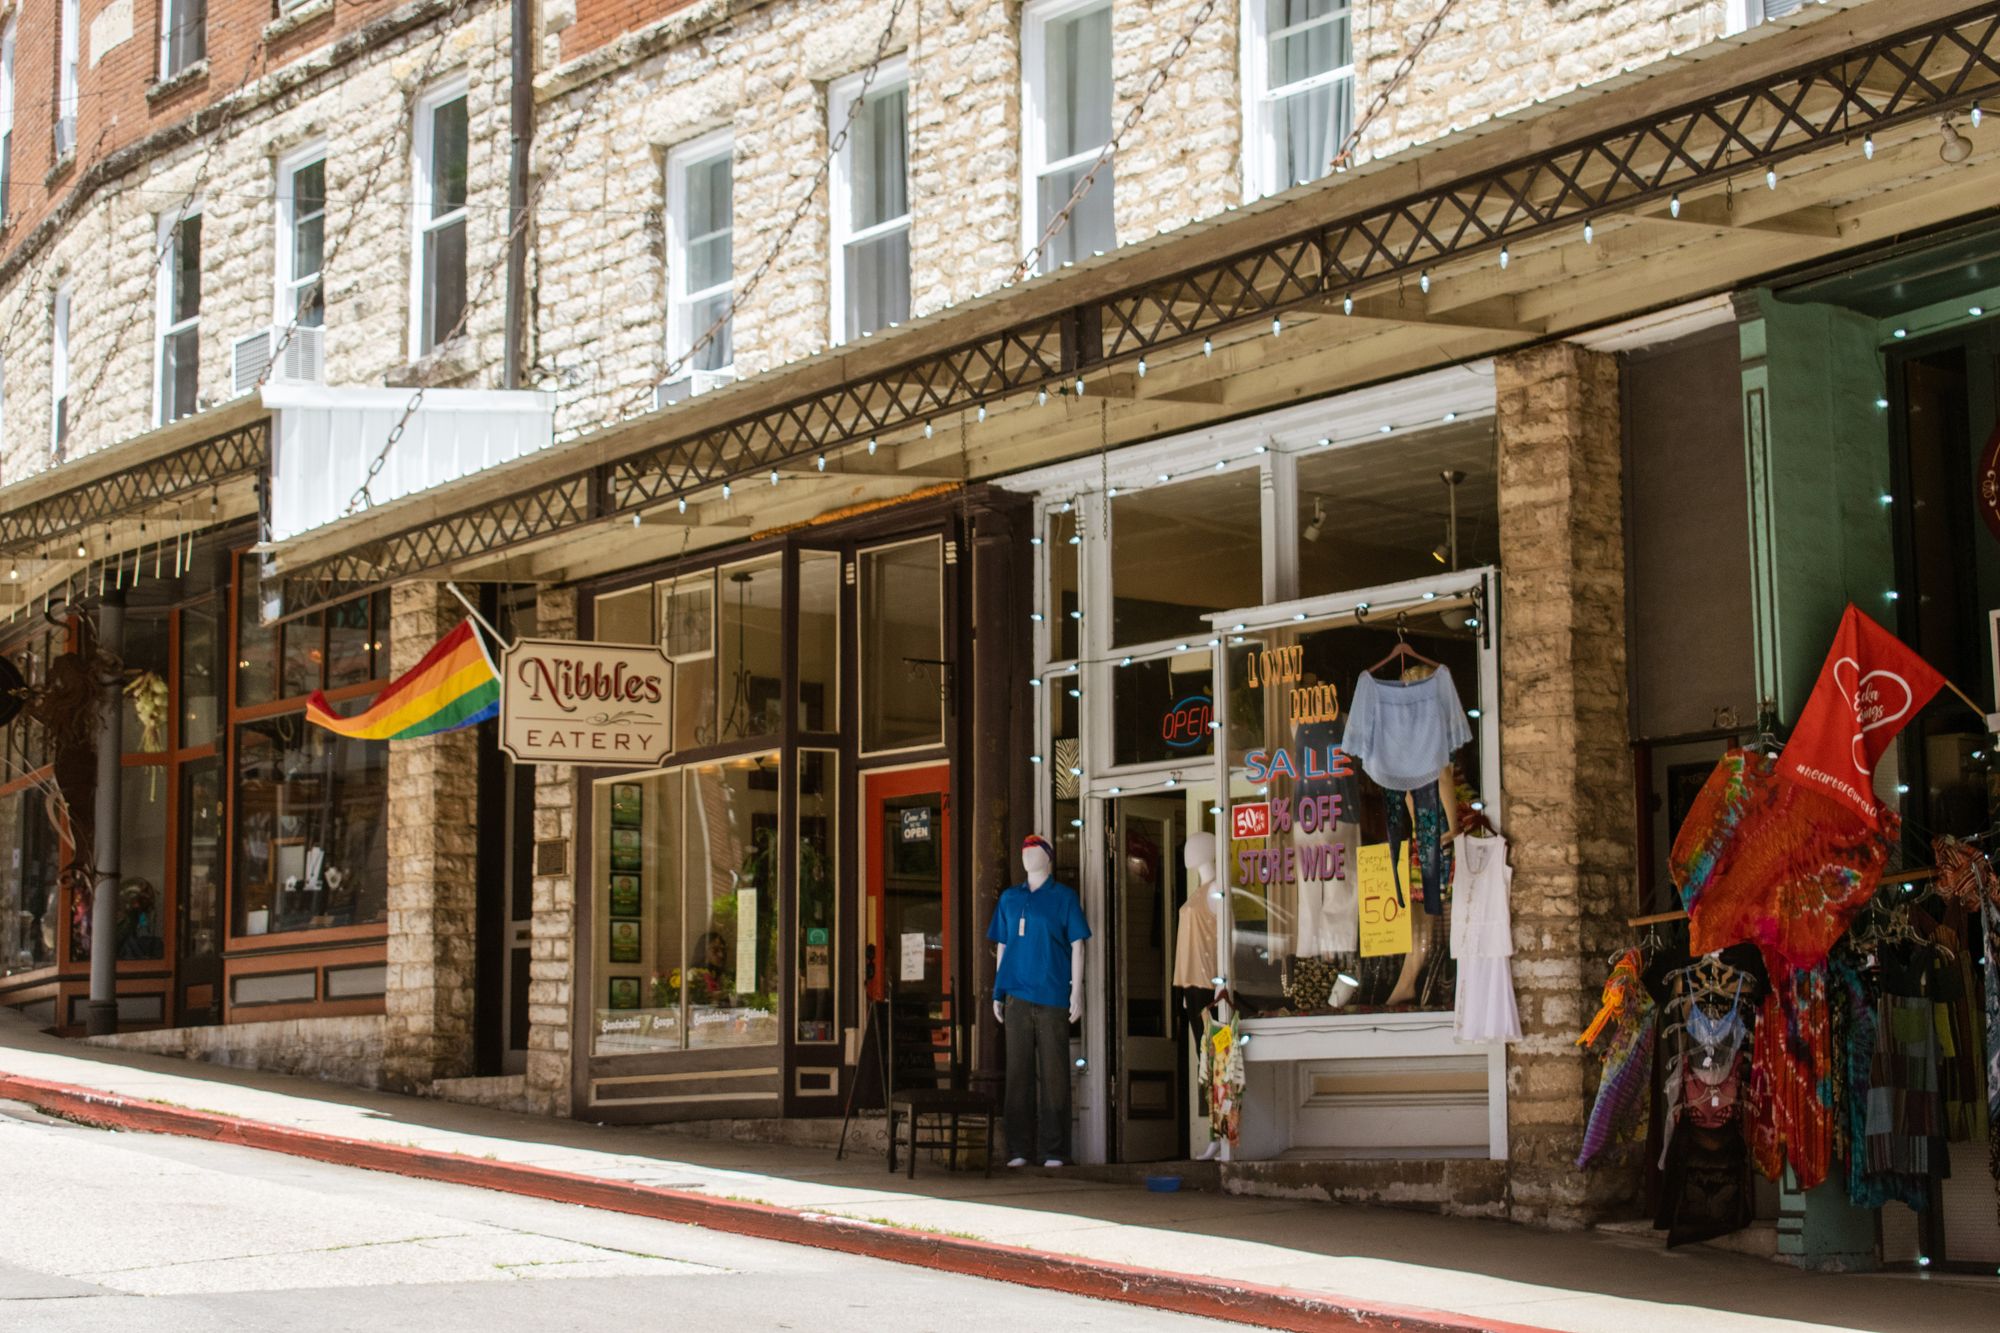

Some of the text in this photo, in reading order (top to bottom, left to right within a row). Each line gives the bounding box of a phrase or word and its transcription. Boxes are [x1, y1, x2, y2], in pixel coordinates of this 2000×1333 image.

[518, 657, 662, 712] Nibbles
[1248, 645, 1303, 688] LOWEST
[1163, 705, 1214, 739] OPEN
[1290, 684, 1339, 725] PRICES
[527, 730, 653, 750] EATERY
[1245, 744, 1353, 784] SALE
[1299, 795, 1342, 832] OFF
[904, 827, 928, 839] OPEN
[1239, 843, 1345, 885] STORE WIDE
[1364, 896, 1398, 924] 50
